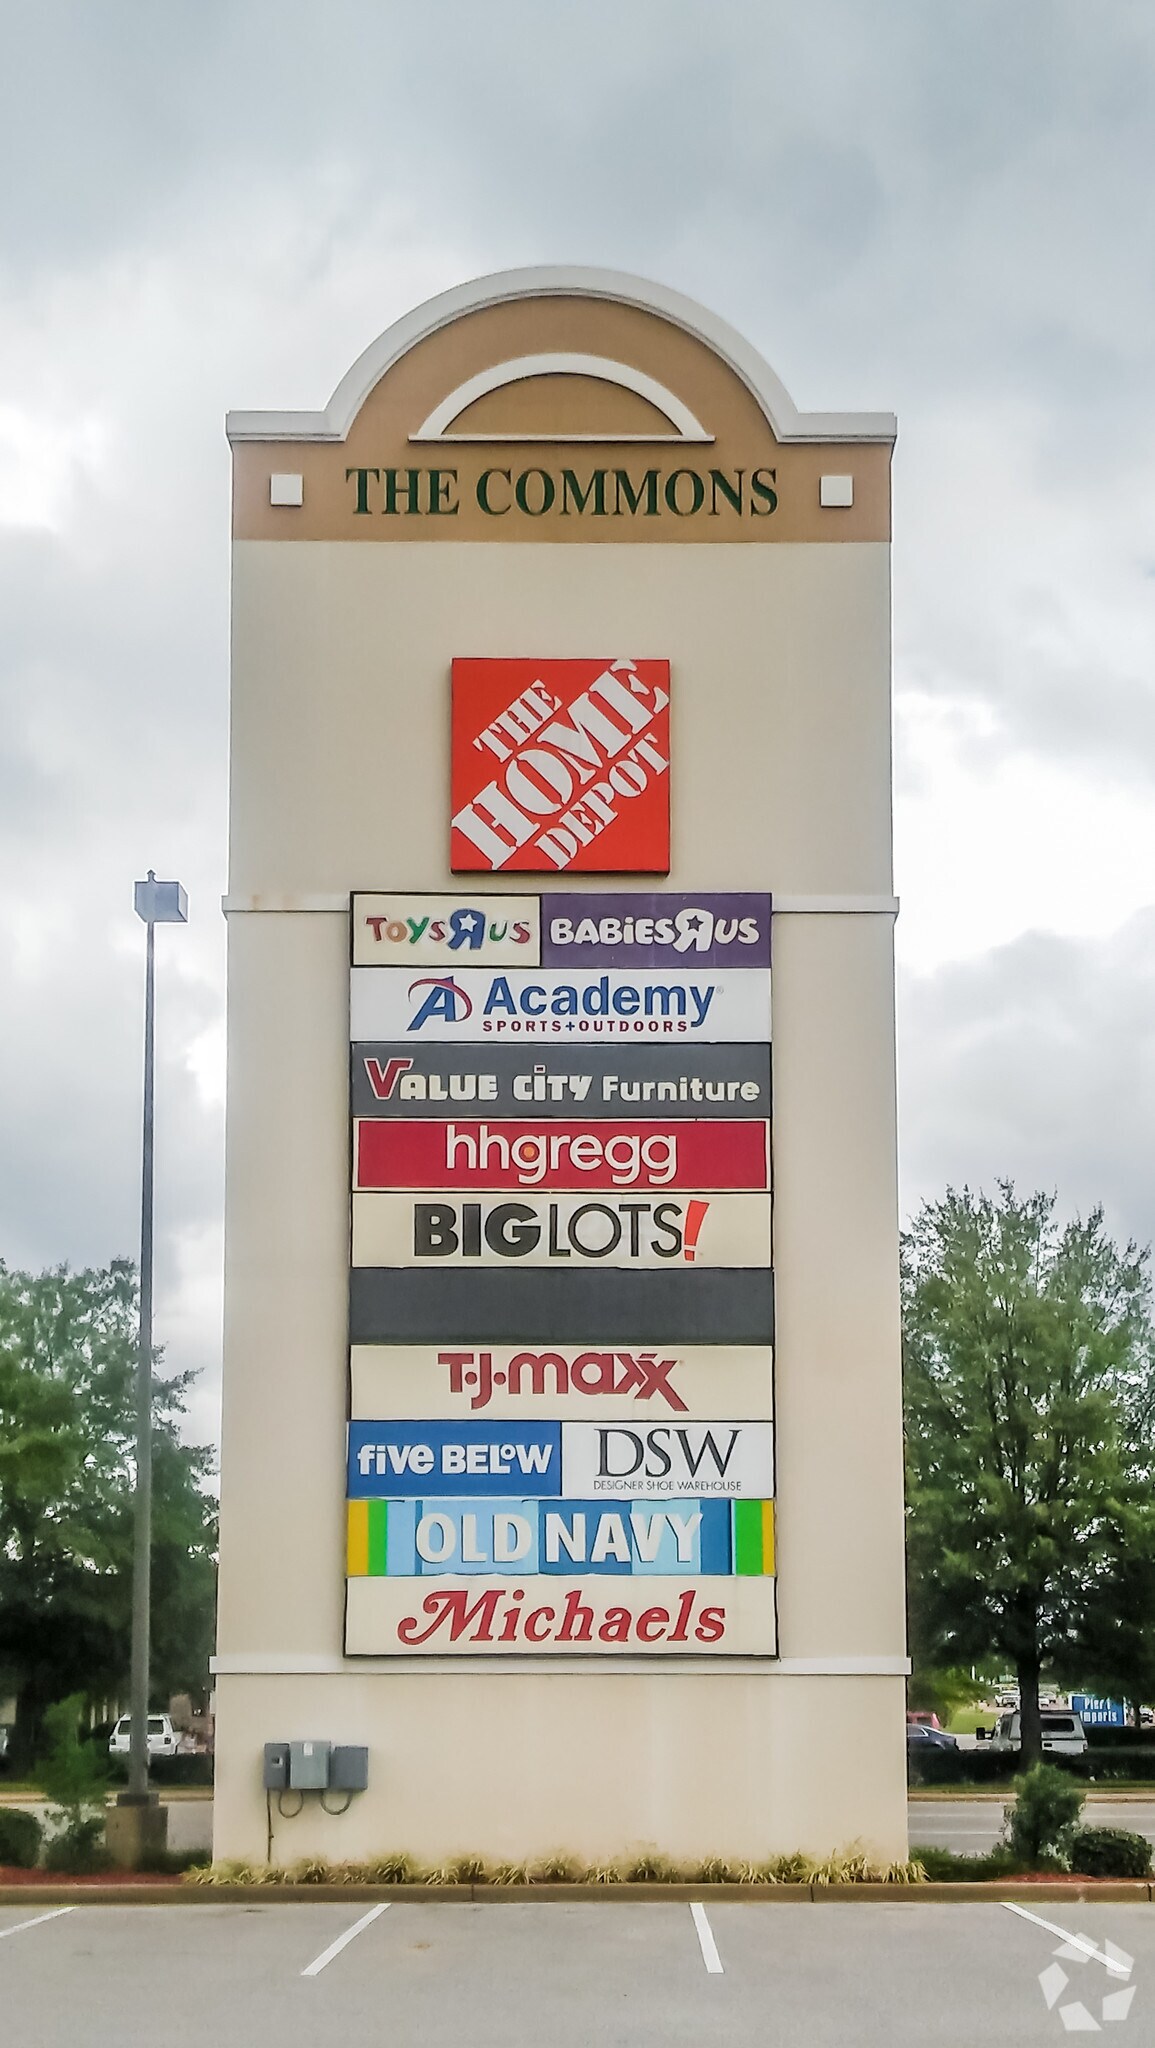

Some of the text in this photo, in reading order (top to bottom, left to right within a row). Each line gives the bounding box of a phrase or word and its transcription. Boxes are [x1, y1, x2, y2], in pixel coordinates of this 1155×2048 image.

[345, 467, 778, 517] THE COMMONS
[472, 679, 562, 764] THE
[452, 658, 669, 871] HOME
[533, 732, 669, 871] DEPOT
[482, 975, 715, 1028] Academy
[363, 1057, 499, 1101] VALUE
[601, 1075, 761, 1102] Furniture
[446, 1124, 678, 1185] hhgregg
[357, 1444, 435, 1475] five
[593, 1428, 743, 1478] DSW
[593, 1480, 742, 1491] DESIGNER SHOE WAREHOUSE
[415, 1513, 703, 1563] OLD NAVY
[397, 1589, 726, 1646] Michaels
